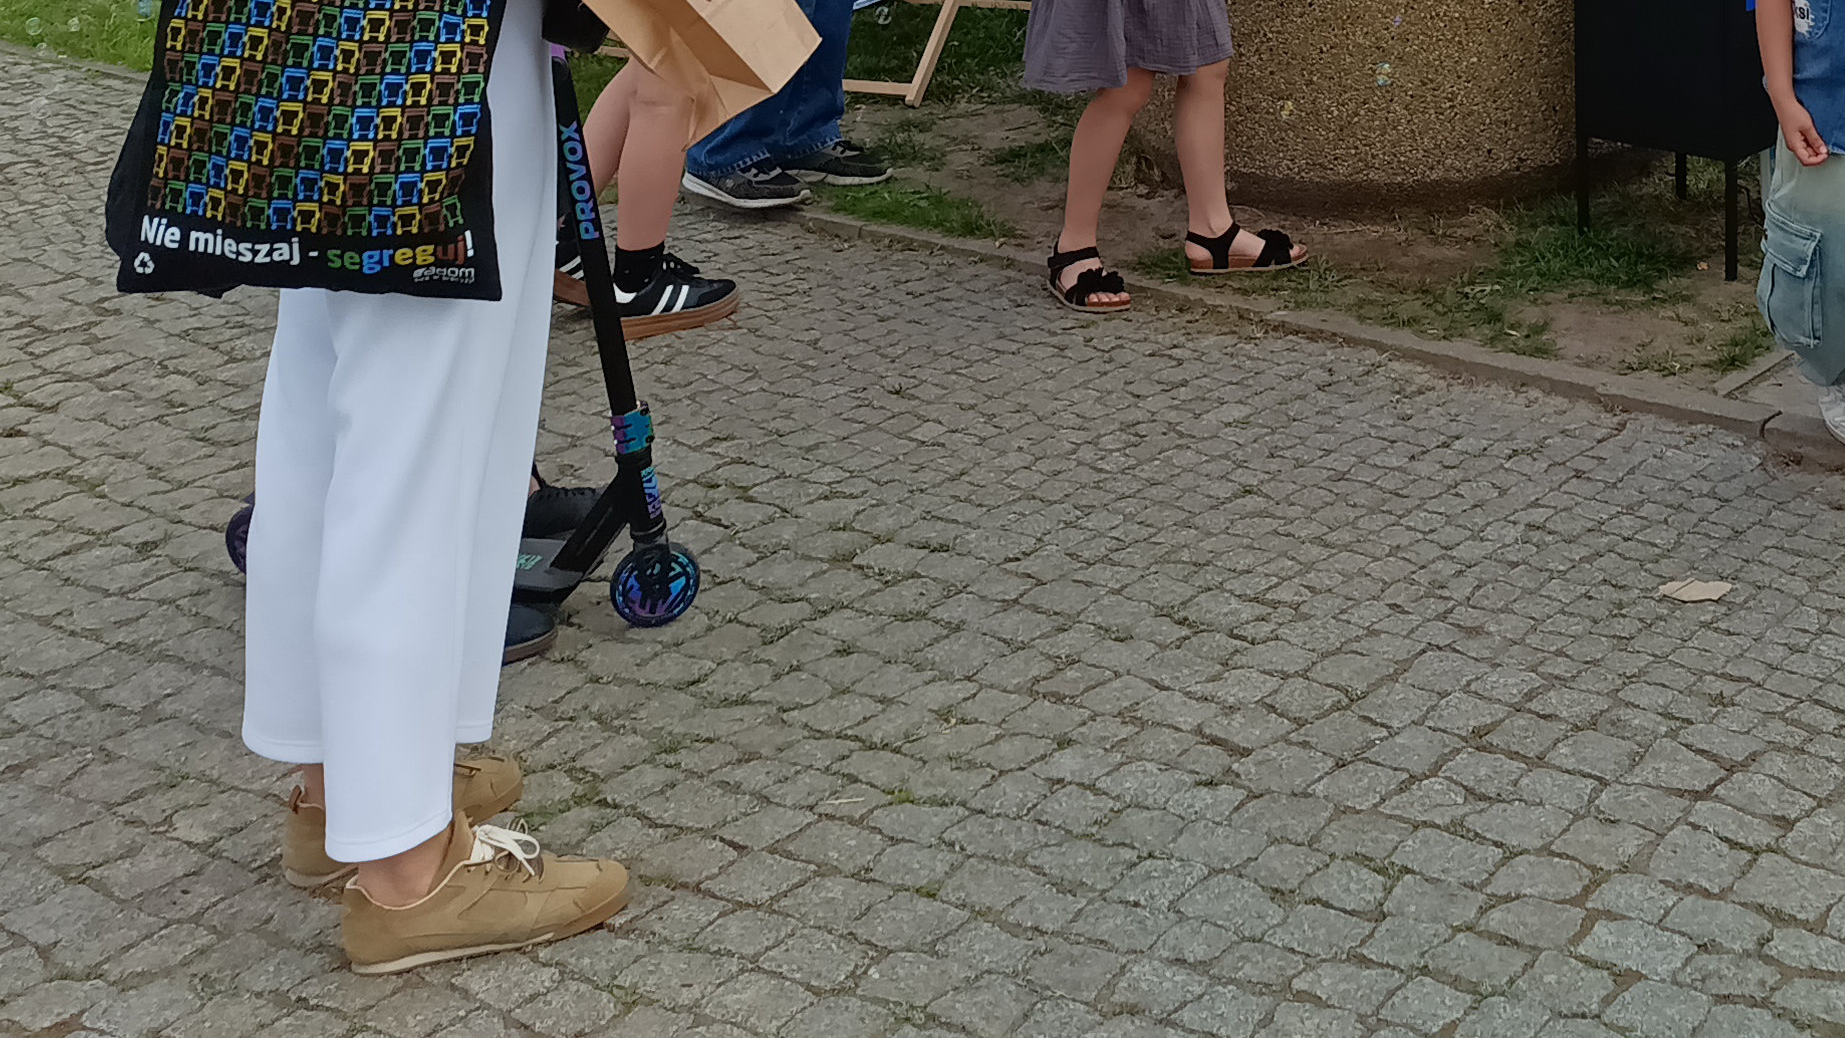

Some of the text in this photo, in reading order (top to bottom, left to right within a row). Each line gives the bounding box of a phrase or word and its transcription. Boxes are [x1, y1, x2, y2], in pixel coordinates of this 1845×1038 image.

[558, 120, 601, 241] PROVOX
[139, 214, 181, 249] Nie
[188, 228, 301, 266] mieszaj
[326, 229, 476, 275] segreguj!
